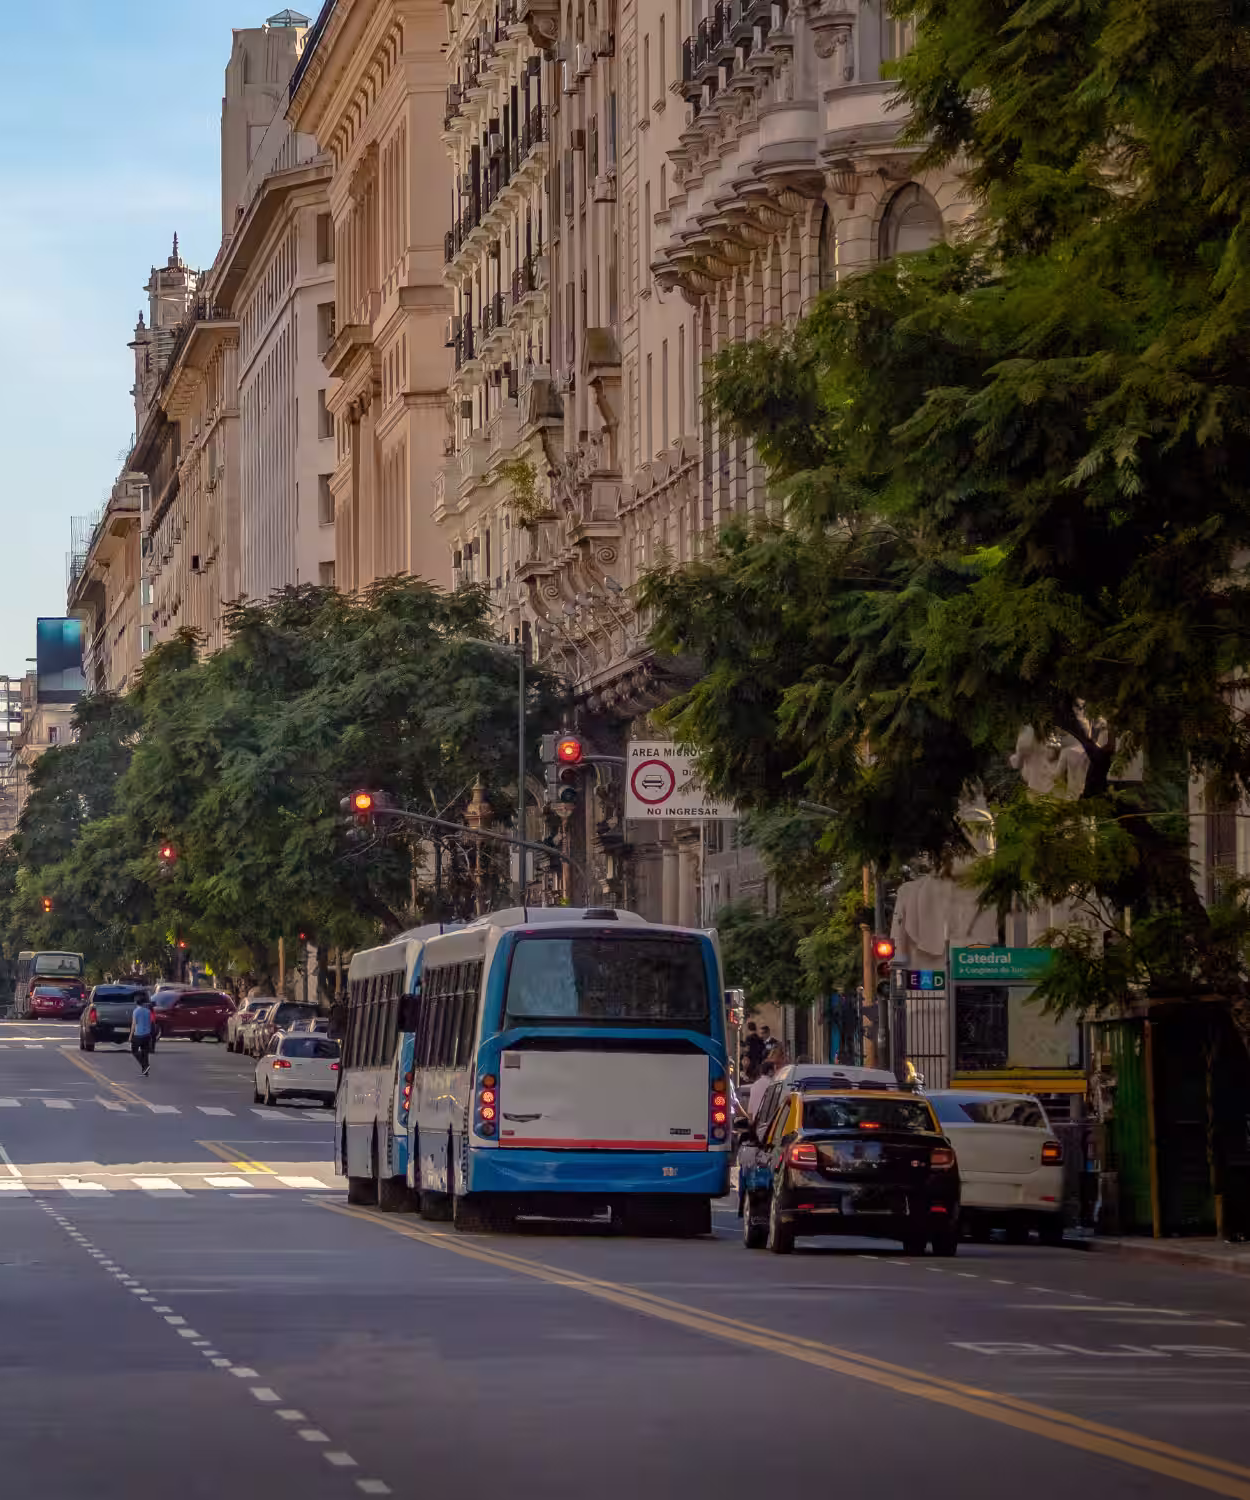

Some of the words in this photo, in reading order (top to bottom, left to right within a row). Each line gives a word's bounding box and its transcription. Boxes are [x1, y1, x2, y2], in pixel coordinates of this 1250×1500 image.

[632, 748, 660, 757] AREA
[647, 808, 662, 816] NO
[665, 808, 718, 816] INGRESAR
[958, 952, 1011, 964] Catedral
